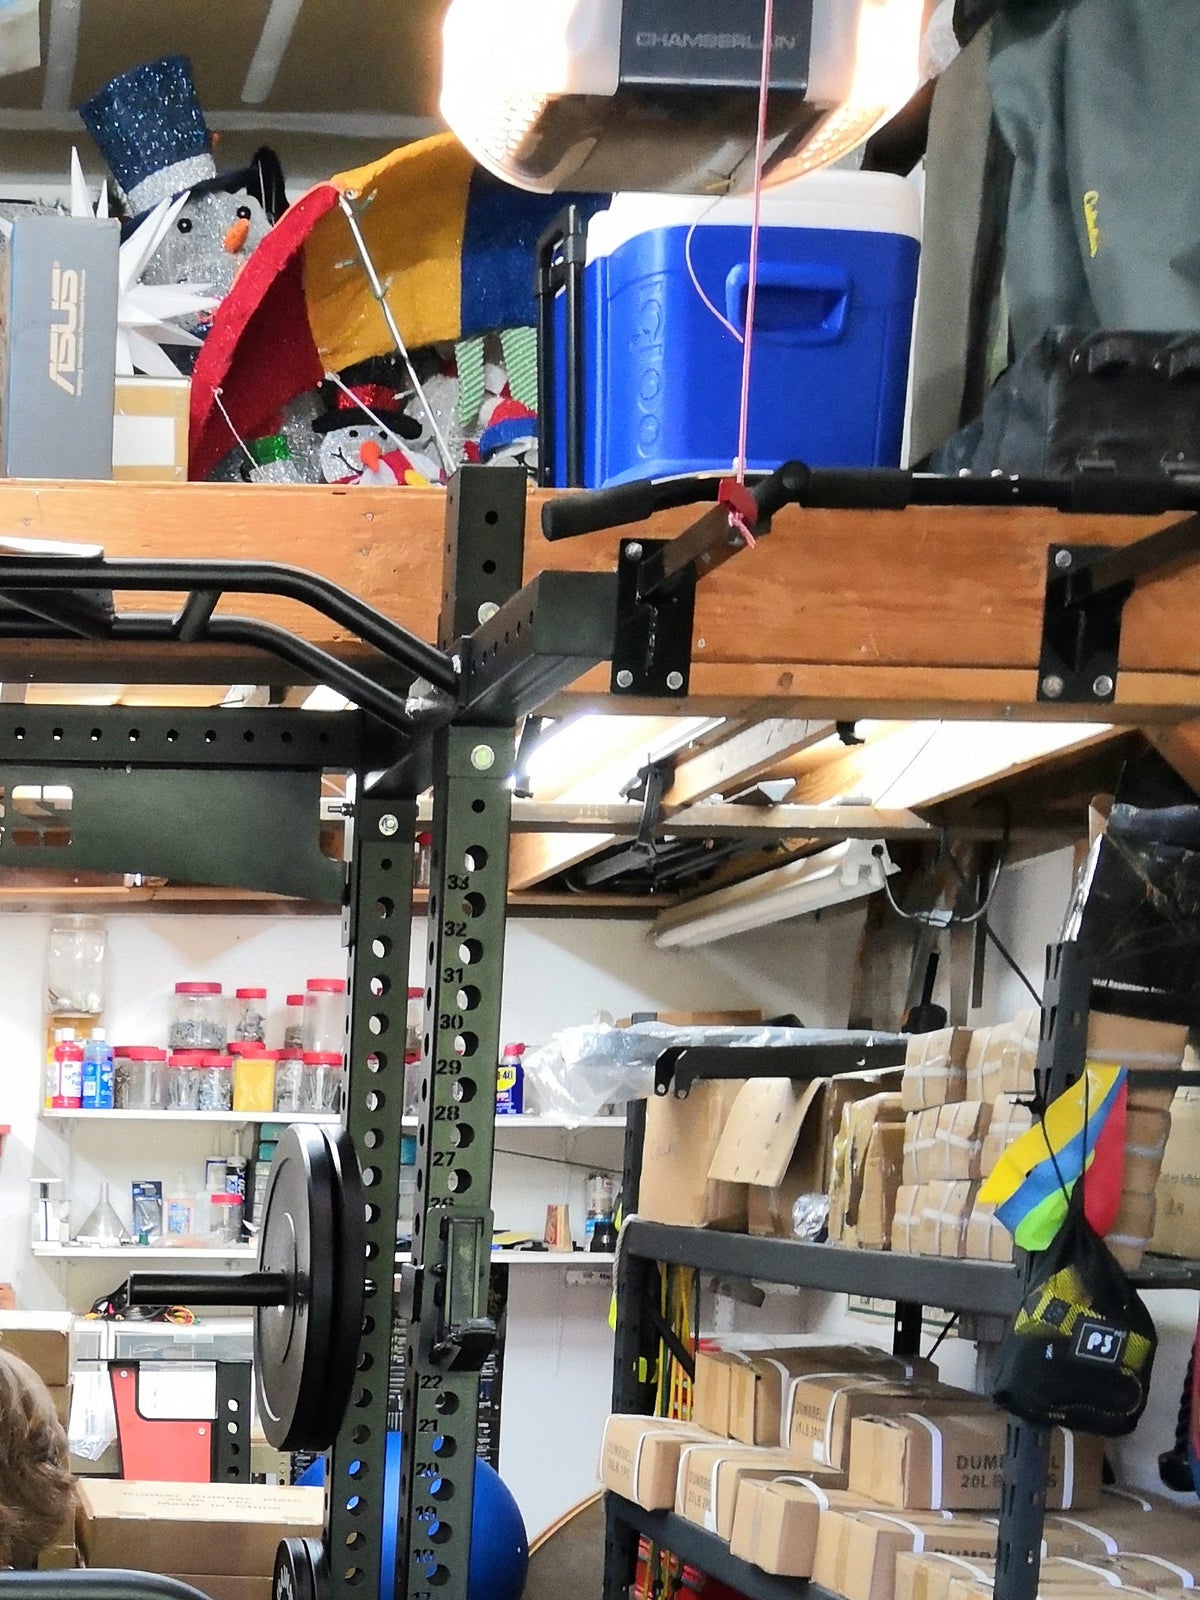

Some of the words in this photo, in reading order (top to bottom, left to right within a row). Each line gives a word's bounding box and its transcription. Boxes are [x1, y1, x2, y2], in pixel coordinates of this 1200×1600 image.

[635, 31, 796, 50] CHAMBERLIN
[49, 260, 78, 395] ASUS
[444, 921, 467, 937] 32
[442, 967, 464, 984] 31
[440, 1014, 463, 1030] 30
[436, 1059, 461, 1075] 29
[434, 1105, 460, 1121] 28
[432, 1151, 456, 1167] 27
[420, 1375, 443, 1389] 22
[418, 1418, 439, 1433] 21
[415, 1462, 440, 1478] 20
